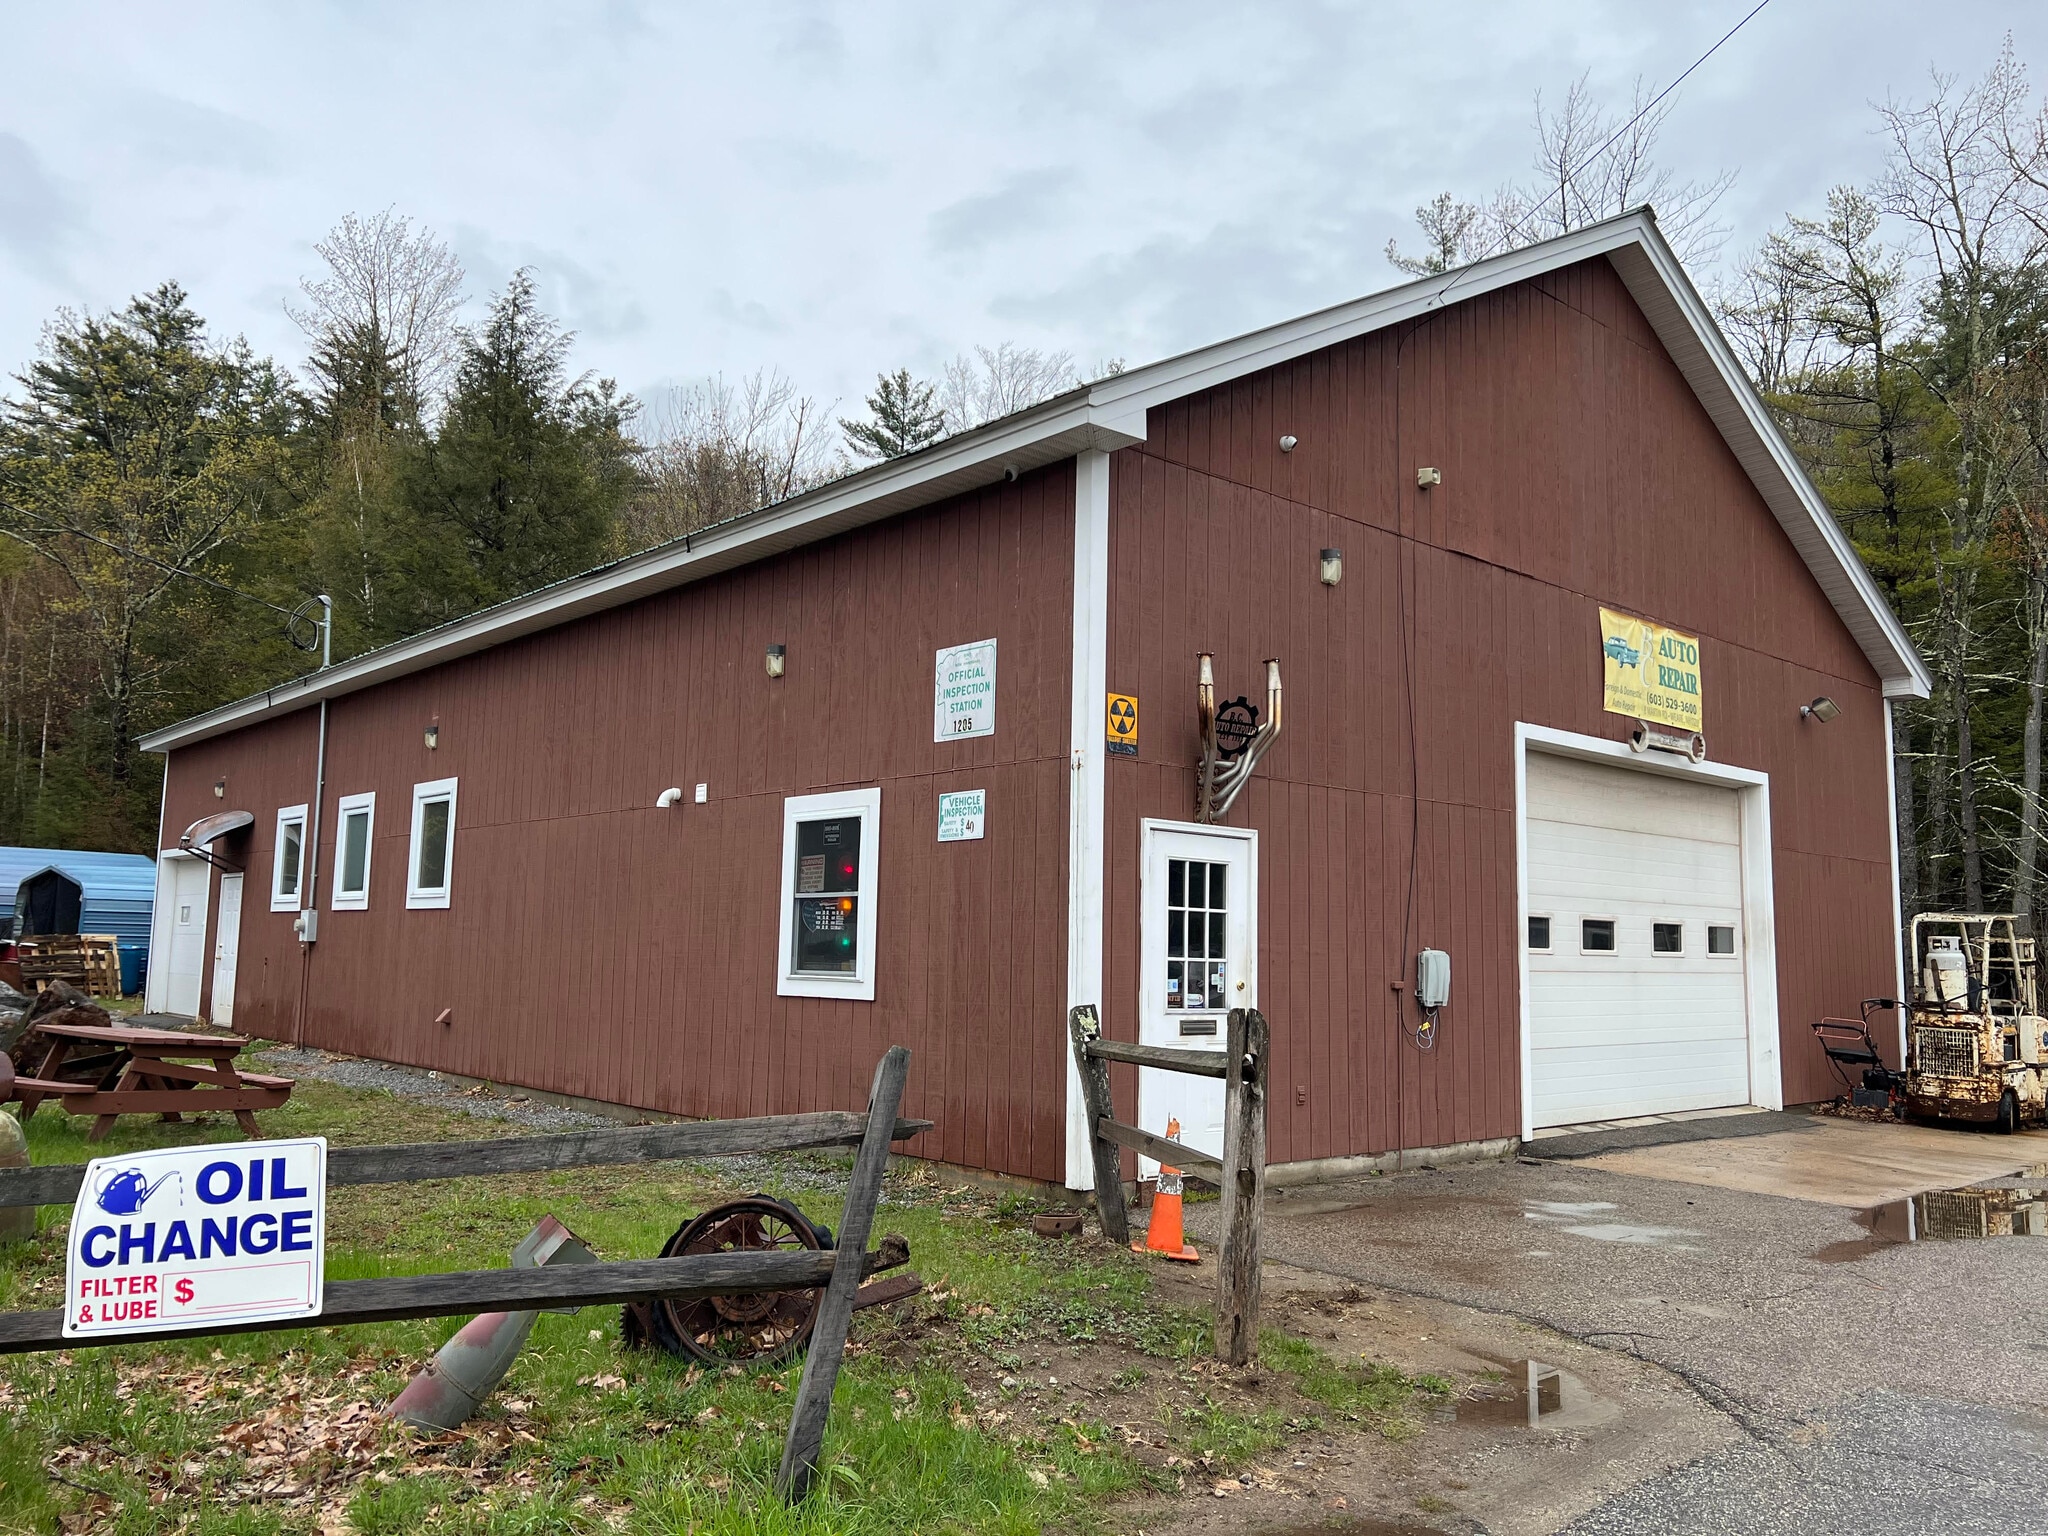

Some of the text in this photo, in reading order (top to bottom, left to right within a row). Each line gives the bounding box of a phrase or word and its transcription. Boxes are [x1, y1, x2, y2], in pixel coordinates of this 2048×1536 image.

[1658, 635, 1697, 665] AUTO
[948, 667, 985, 682] OFFICIAL
[1658, 664, 1698, 695] REPAIR
[943, 681, 990, 699] INSPECTION
[950, 699, 982, 714] STATION
[1647, 691, 1664, 708] (603)
[1665, 697, 1697, 715] 529-3600
[953, 718, 972, 732] 1205
[1215, 721, 1257, 736] UTO REPAIR
[949, 795, 981, 807] VEHICLE
[944, 805, 983, 818] INSPECTION
[196, 1157, 307, 1204] OIL
[80, 1210, 313, 1268] CHANGE
[80, 1275, 195, 1305] FILTER $
[79, 1300, 157, 1323] & LUBE
